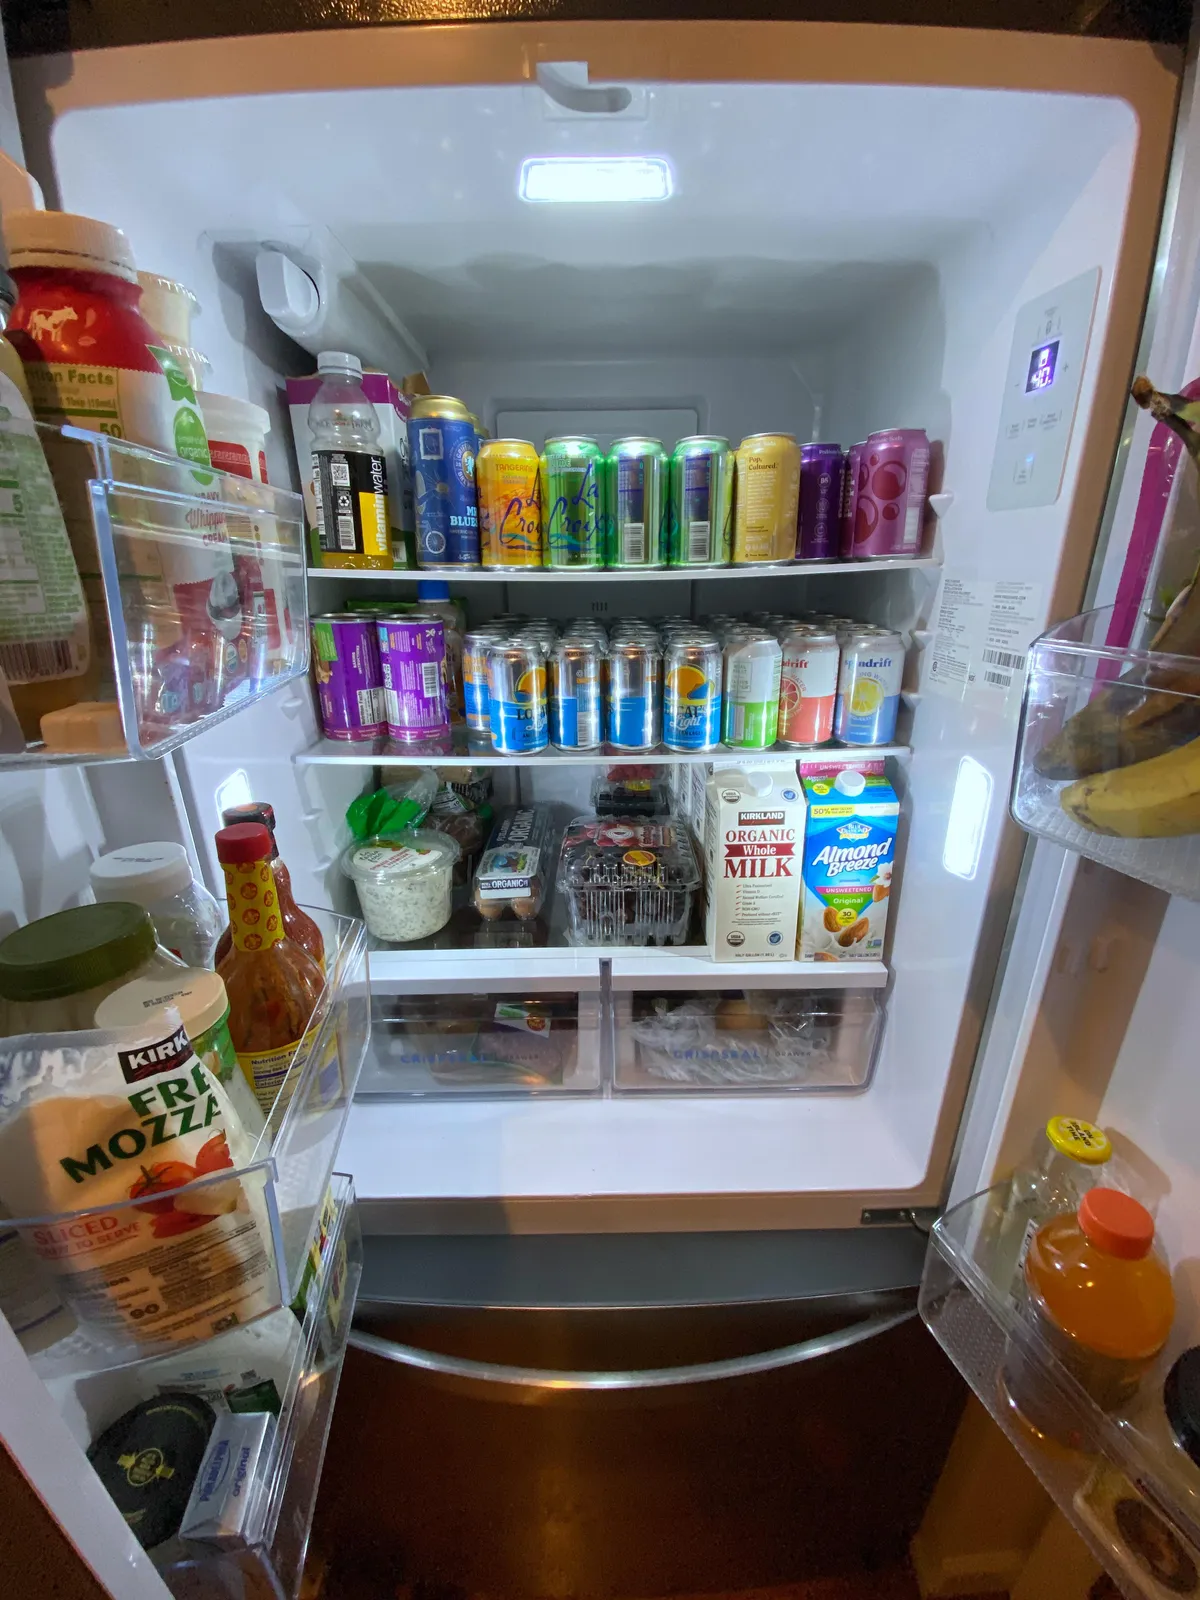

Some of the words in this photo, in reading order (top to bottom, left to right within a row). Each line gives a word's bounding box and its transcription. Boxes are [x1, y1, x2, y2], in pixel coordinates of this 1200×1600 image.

[67, 368, 114, 385] Facts
[99, 422, 122, 438] 50
[844, 657, 893, 670] spndrift
[669, 714, 701, 731] Light
[741, 812, 784, 820] KIRKLAND
[725, 828, 796, 843] ORGANIC
[743, 844, 777, 855] Whole
[812, 837, 893, 866] Almond
[724, 857, 793, 878] MILK
[826, 857, 879, 877] Breeze
[491, 879, 524, 889] ORGANIC
[833, 897, 864, 905] Original
[127, 1030, 189, 1070] KIRK
[251, 1054, 287, 1065] Nutrition
[1066, 1125, 1081, 1141] TIME
[33, 1216, 118, 1246] SLICED
[97, 1222, 141, 1244] SERVE
[130, 1303, 161, 1320] 90
